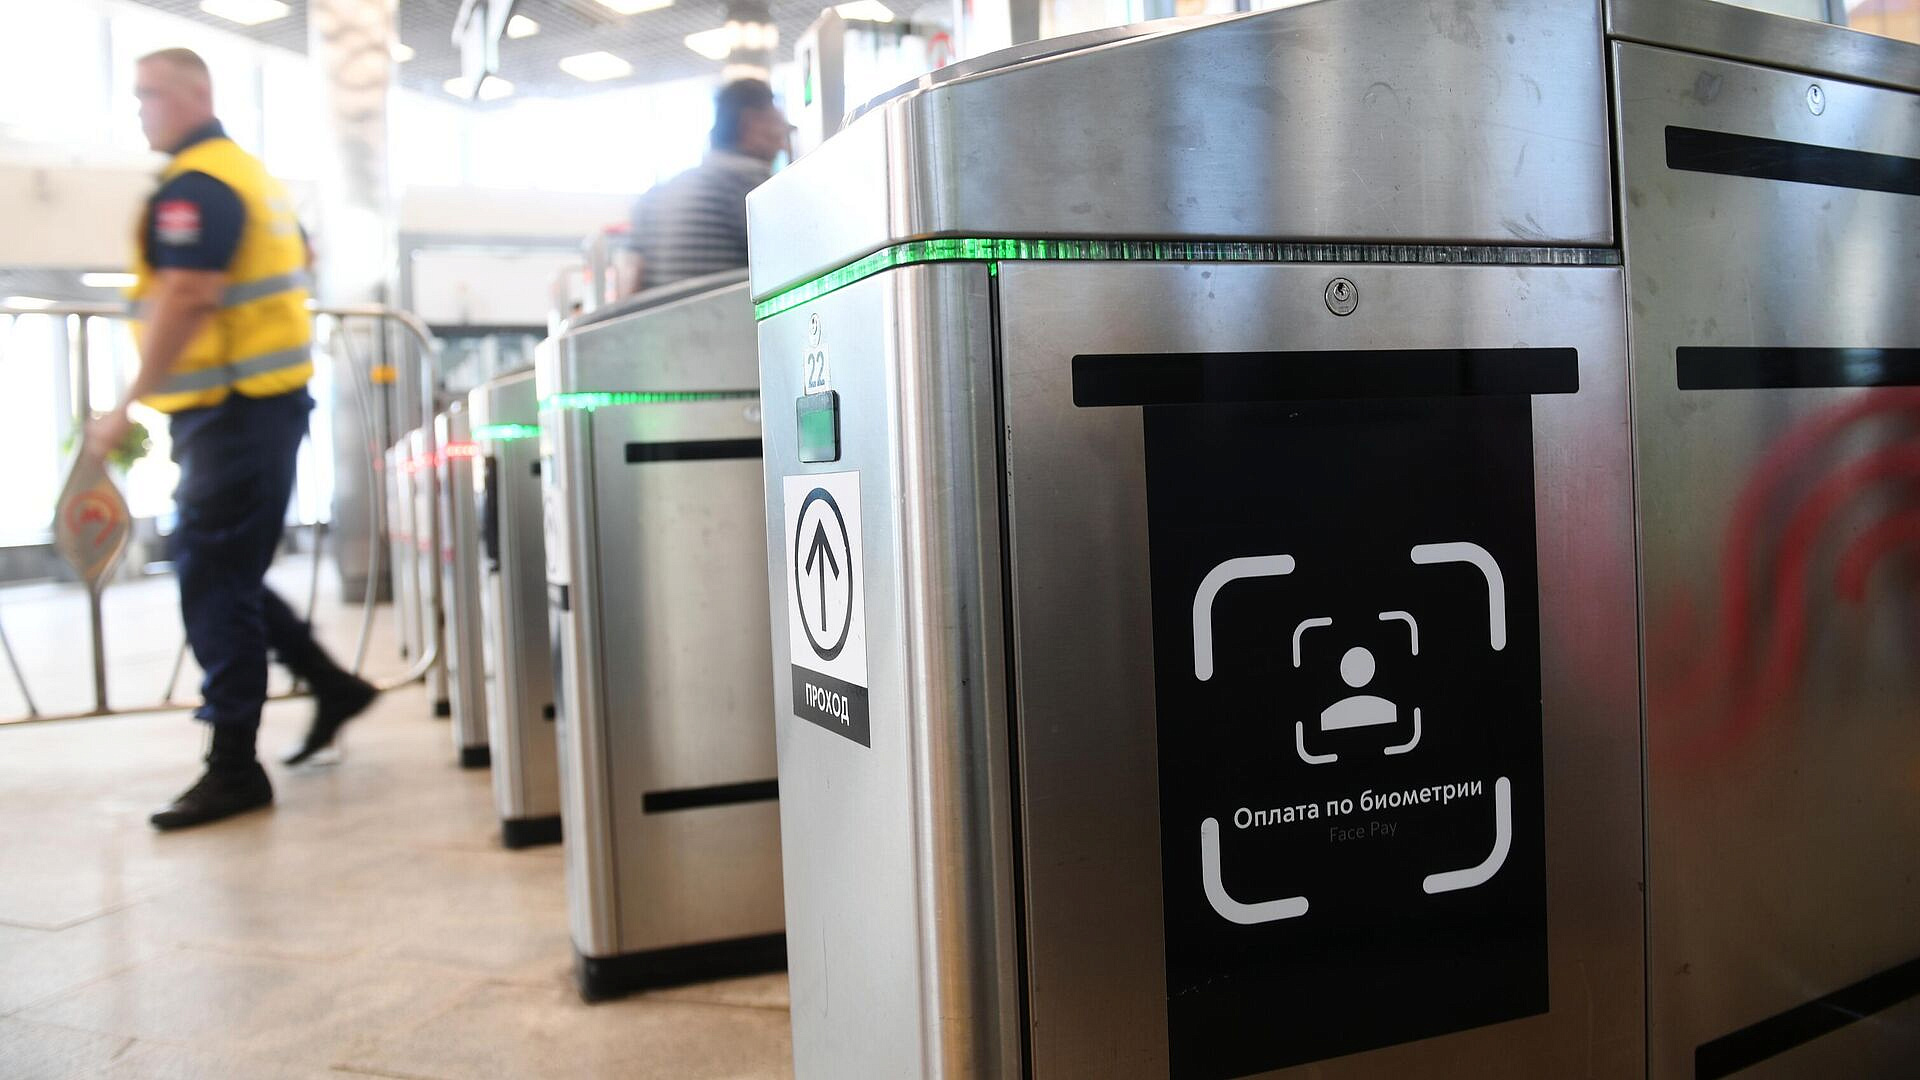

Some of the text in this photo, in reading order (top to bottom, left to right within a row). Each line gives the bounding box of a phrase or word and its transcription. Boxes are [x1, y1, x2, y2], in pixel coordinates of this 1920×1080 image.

[807, 351, 825, 388] 22
[805, 682, 850, 727] ПРОХОД
[1234, 780, 1483, 829] Оплата по биометрии
[1329, 820, 1398, 842] Face Pay
